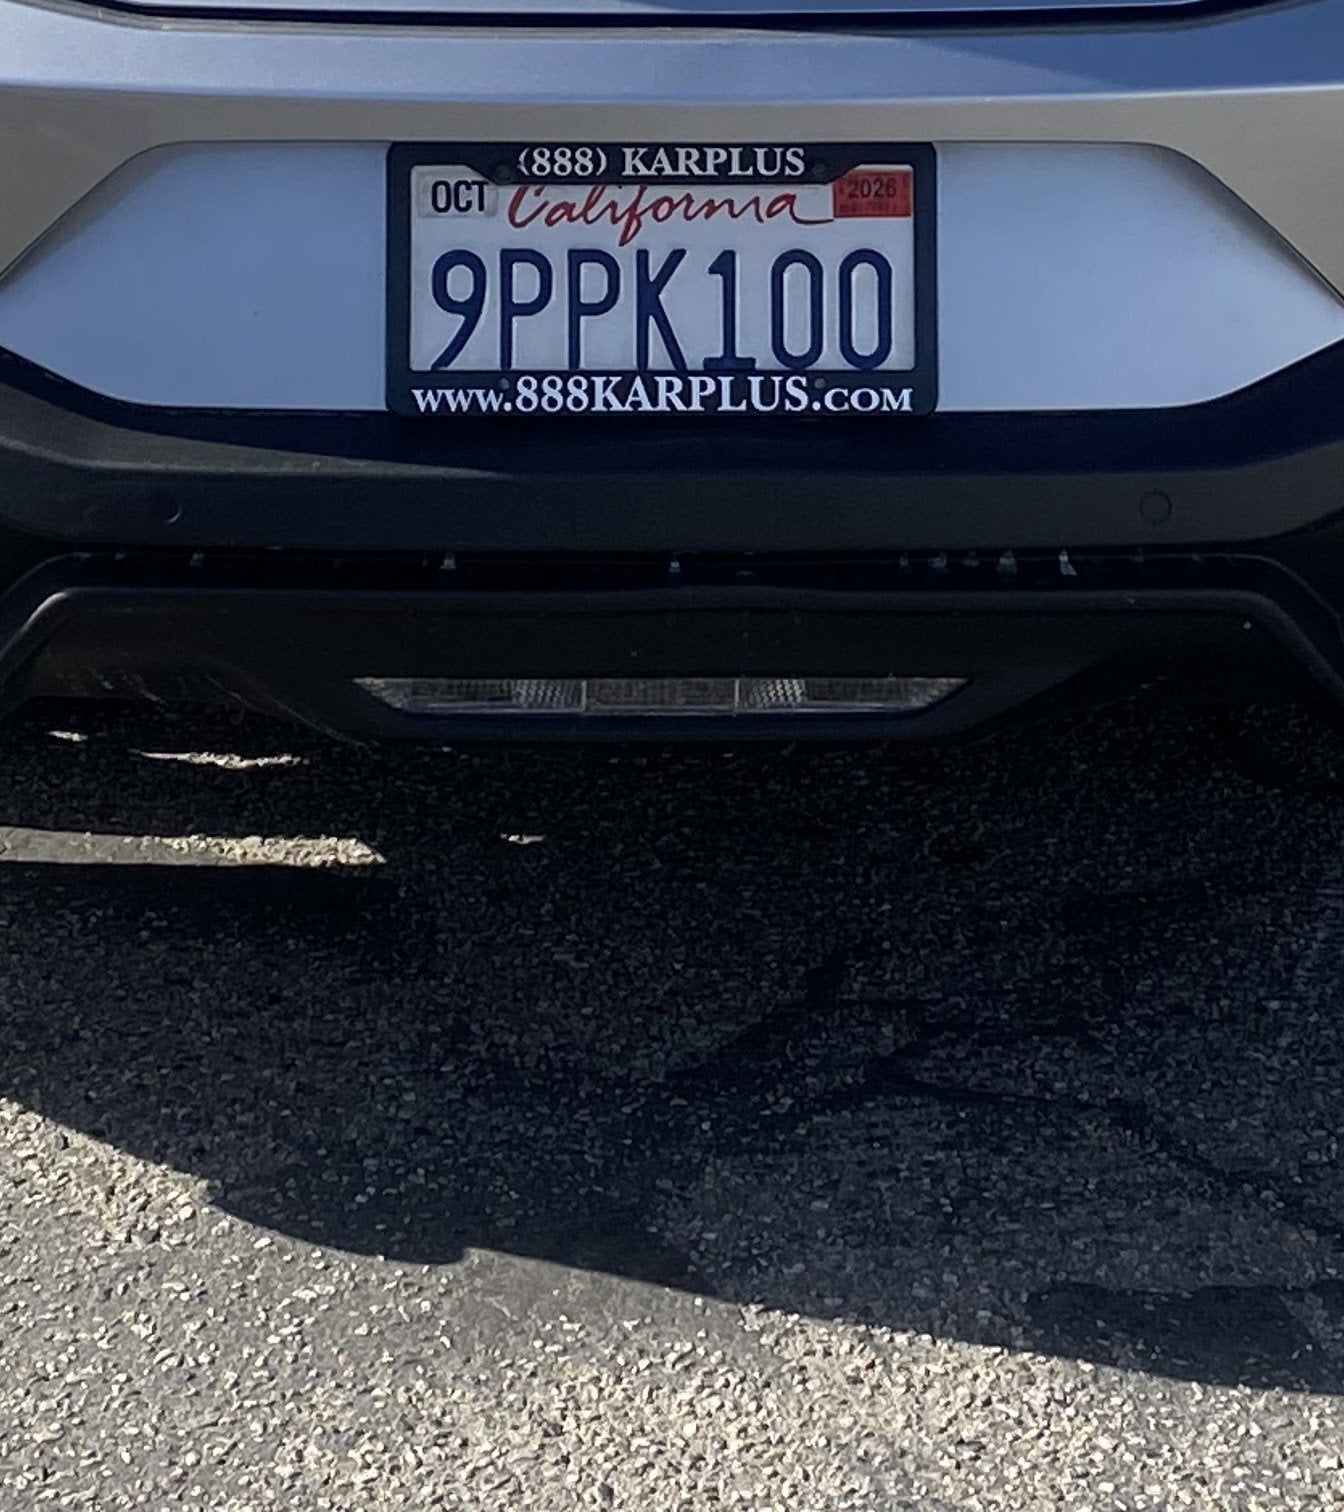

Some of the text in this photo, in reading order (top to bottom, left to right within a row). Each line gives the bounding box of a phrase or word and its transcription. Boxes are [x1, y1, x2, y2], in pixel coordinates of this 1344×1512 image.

[516, 146, 805, 178] (888) KARPLUS
[431, 180, 490, 214] OCT
[508, 184, 834, 247] California
[430, 248, 893, 371] 9PPK100
